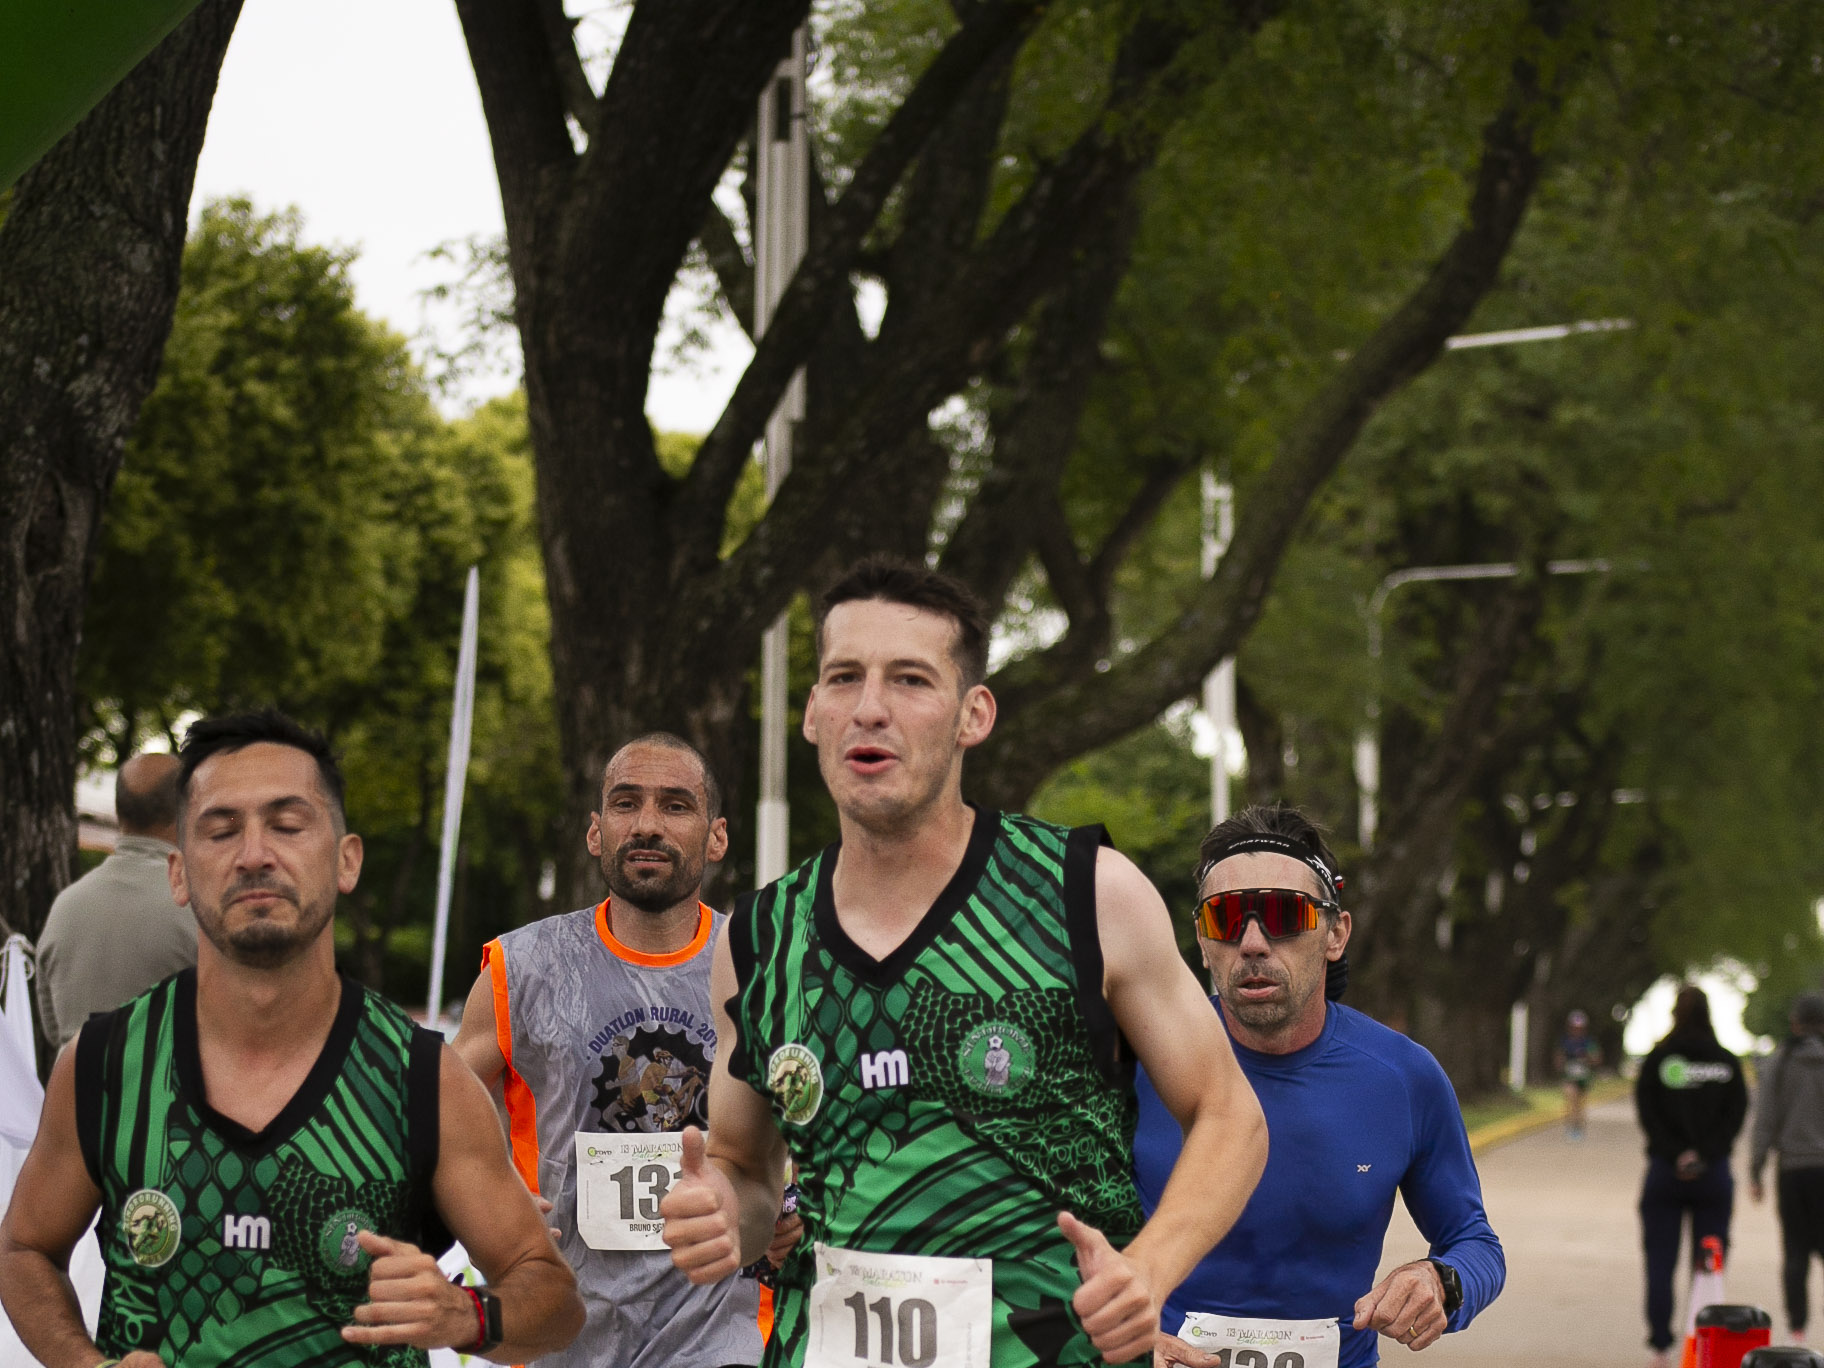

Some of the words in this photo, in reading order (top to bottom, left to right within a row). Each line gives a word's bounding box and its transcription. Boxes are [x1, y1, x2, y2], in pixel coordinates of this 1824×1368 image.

[588, 1007, 645, 1054] DUATLON
[650, 1006, 695, 1030] RURAL
[610, 1164, 682, 1221] 13
[629, 1223, 651, 1232] BRUNO
[844, 1291, 937, 1368] 110
